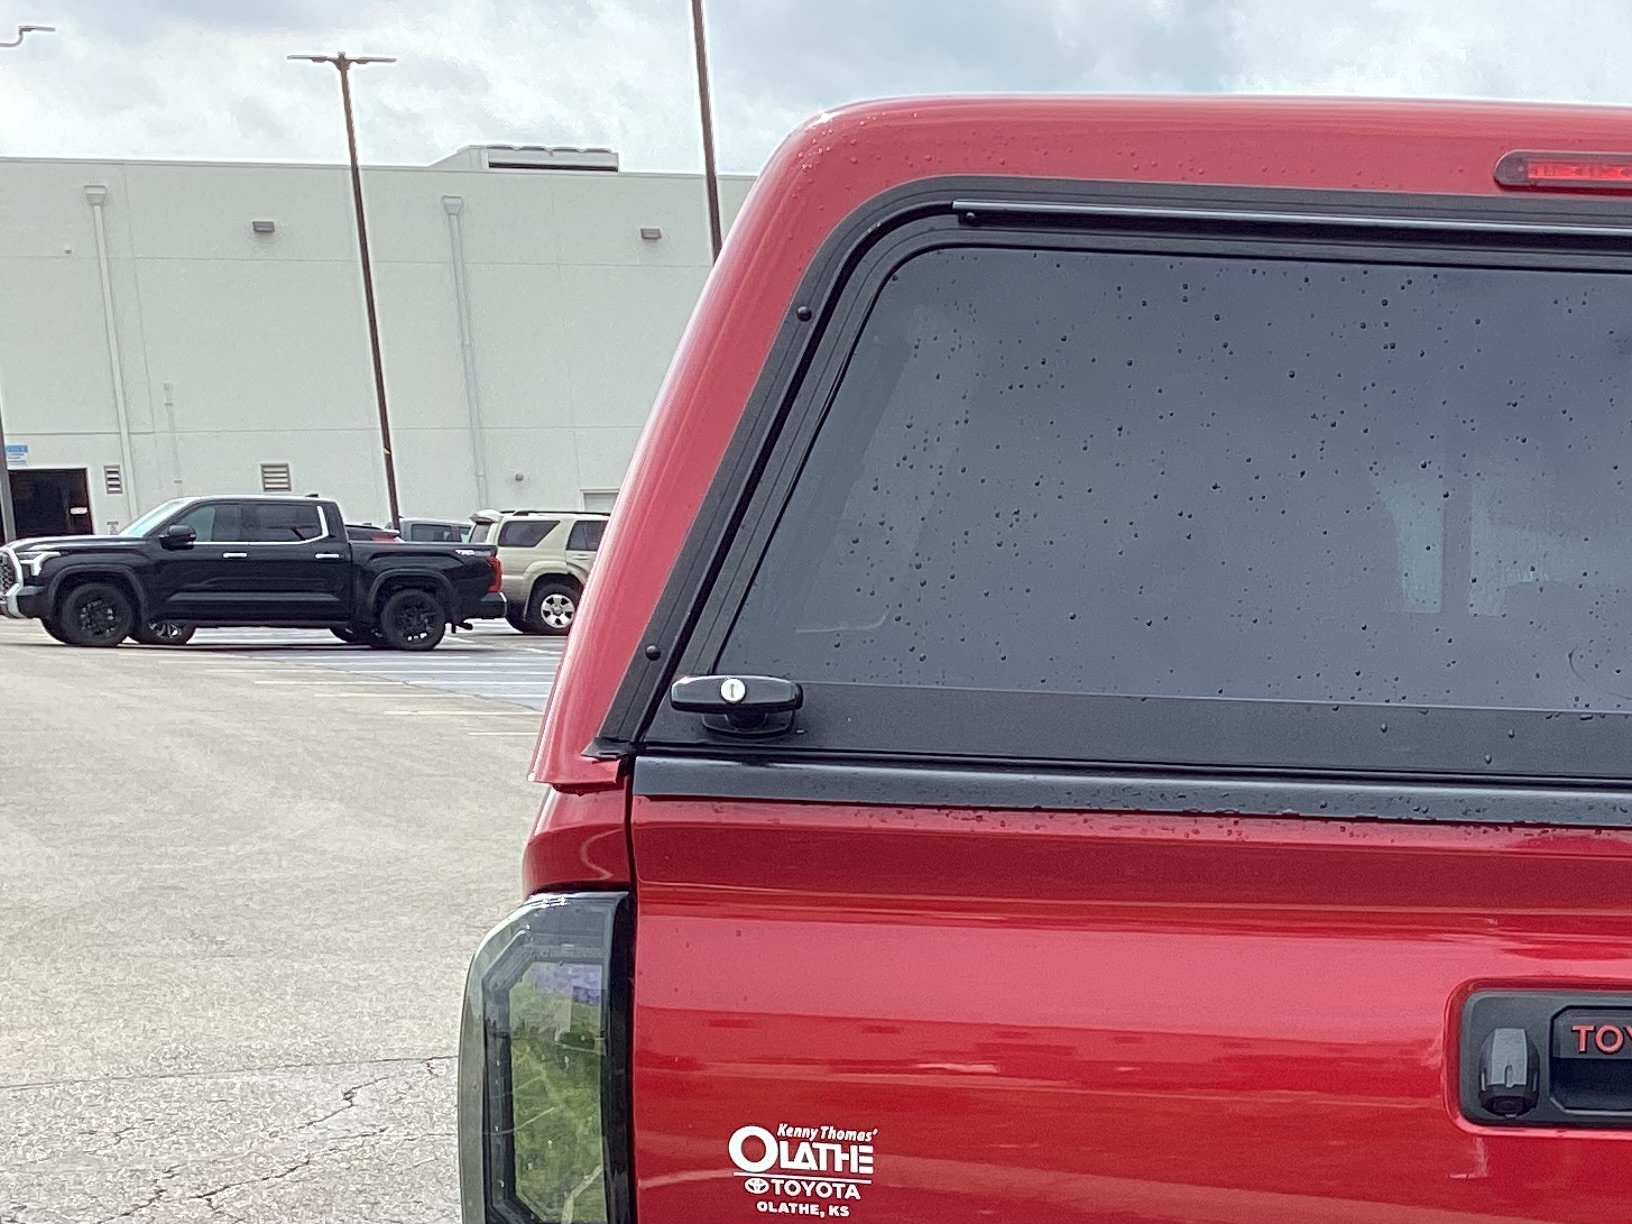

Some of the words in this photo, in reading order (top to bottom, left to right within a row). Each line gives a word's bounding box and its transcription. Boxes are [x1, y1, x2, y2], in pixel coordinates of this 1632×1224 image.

[777, 1123, 818, 1141] Kenny
[820, 1126, 878, 1142] Thomas'
[728, 1125, 874, 1174] OLATHE
[771, 1178, 861, 1200] TOYOTA
[756, 1201, 825, 1218] OLATHE,
[828, 1205, 850, 1217] KS
